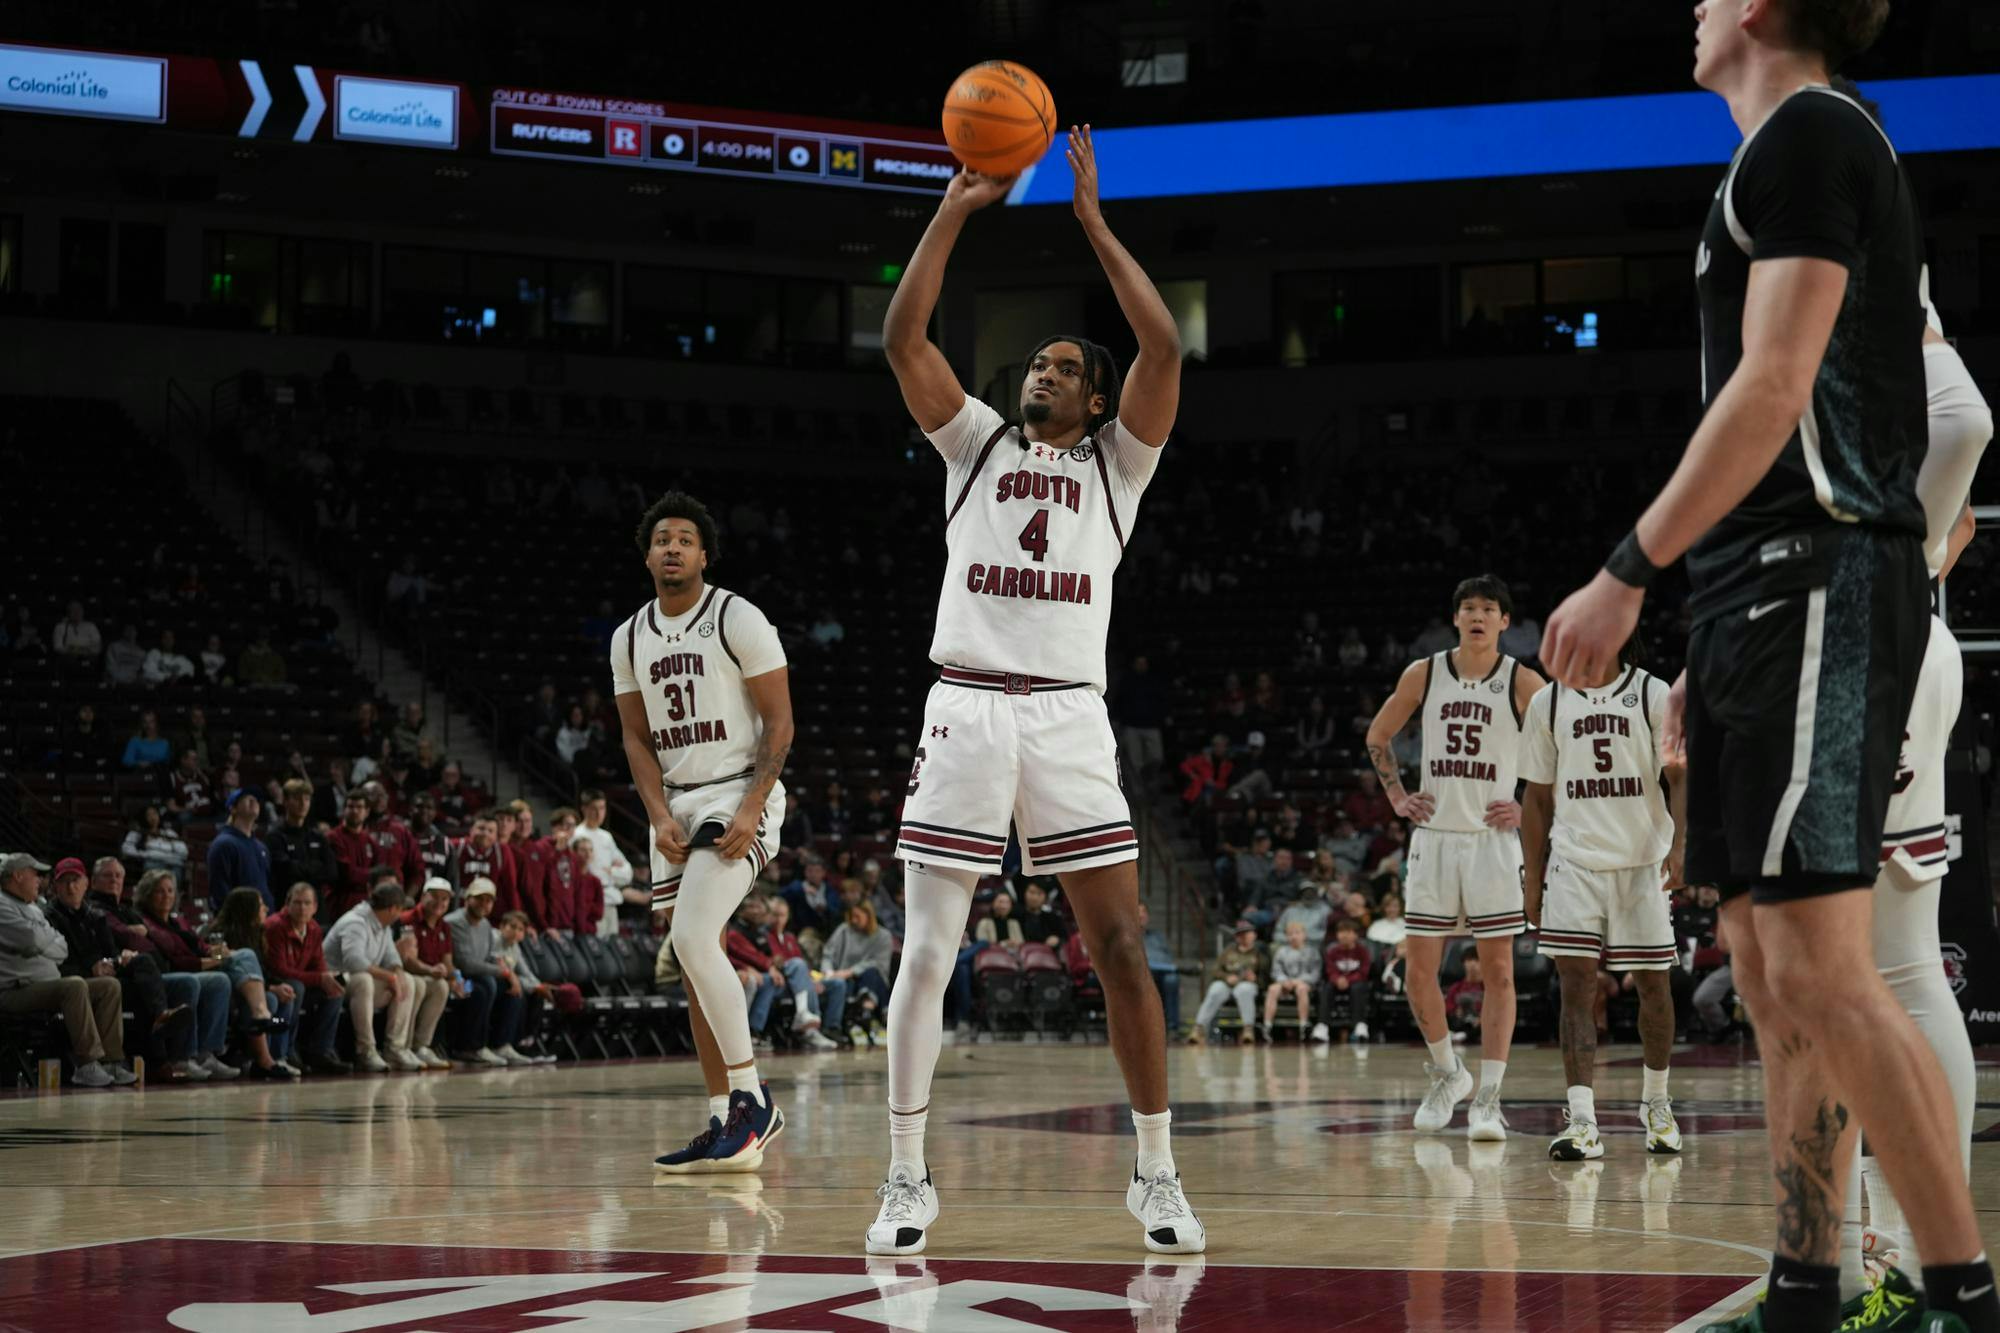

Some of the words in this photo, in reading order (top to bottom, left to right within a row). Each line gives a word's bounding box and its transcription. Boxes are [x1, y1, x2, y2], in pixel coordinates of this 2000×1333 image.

[8, 76, 75, 95] Colonial
[80, 81, 108, 98] Life
[493, 89, 525, 103] OUT
[529, 91, 551, 104] OF
[555, 94, 602, 110] TOWN
[605, 100, 665, 116] SCORES
[347, 106, 412, 126] Colonial
[416, 112, 443, 128] Life
[512, 123, 592, 144] RUTGERS
[614, 127, 636, 150] R
[703, 140, 743, 158] 4:00
[745, 144, 772, 160] PM
[832, 149, 856, 171] M
[873, 158, 955, 179] MICHIGAN
[996, 470, 1081, 514] SOUTH
[1018, 508, 1049, 562] 4
[967, 563, 1092, 605] CAROLINA
[650, 653, 704, 685] SOUTH
[664, 680, 696, 721] 31
[1440, 701, 1492, 726] SOUTH
[1446, 723, 1483, 756] 55
[1573, 713, 1630, 739] SOUTH
[1430, 759, 1497, 782] CAROLINA
[1593, 738, 1613, 773] 5
